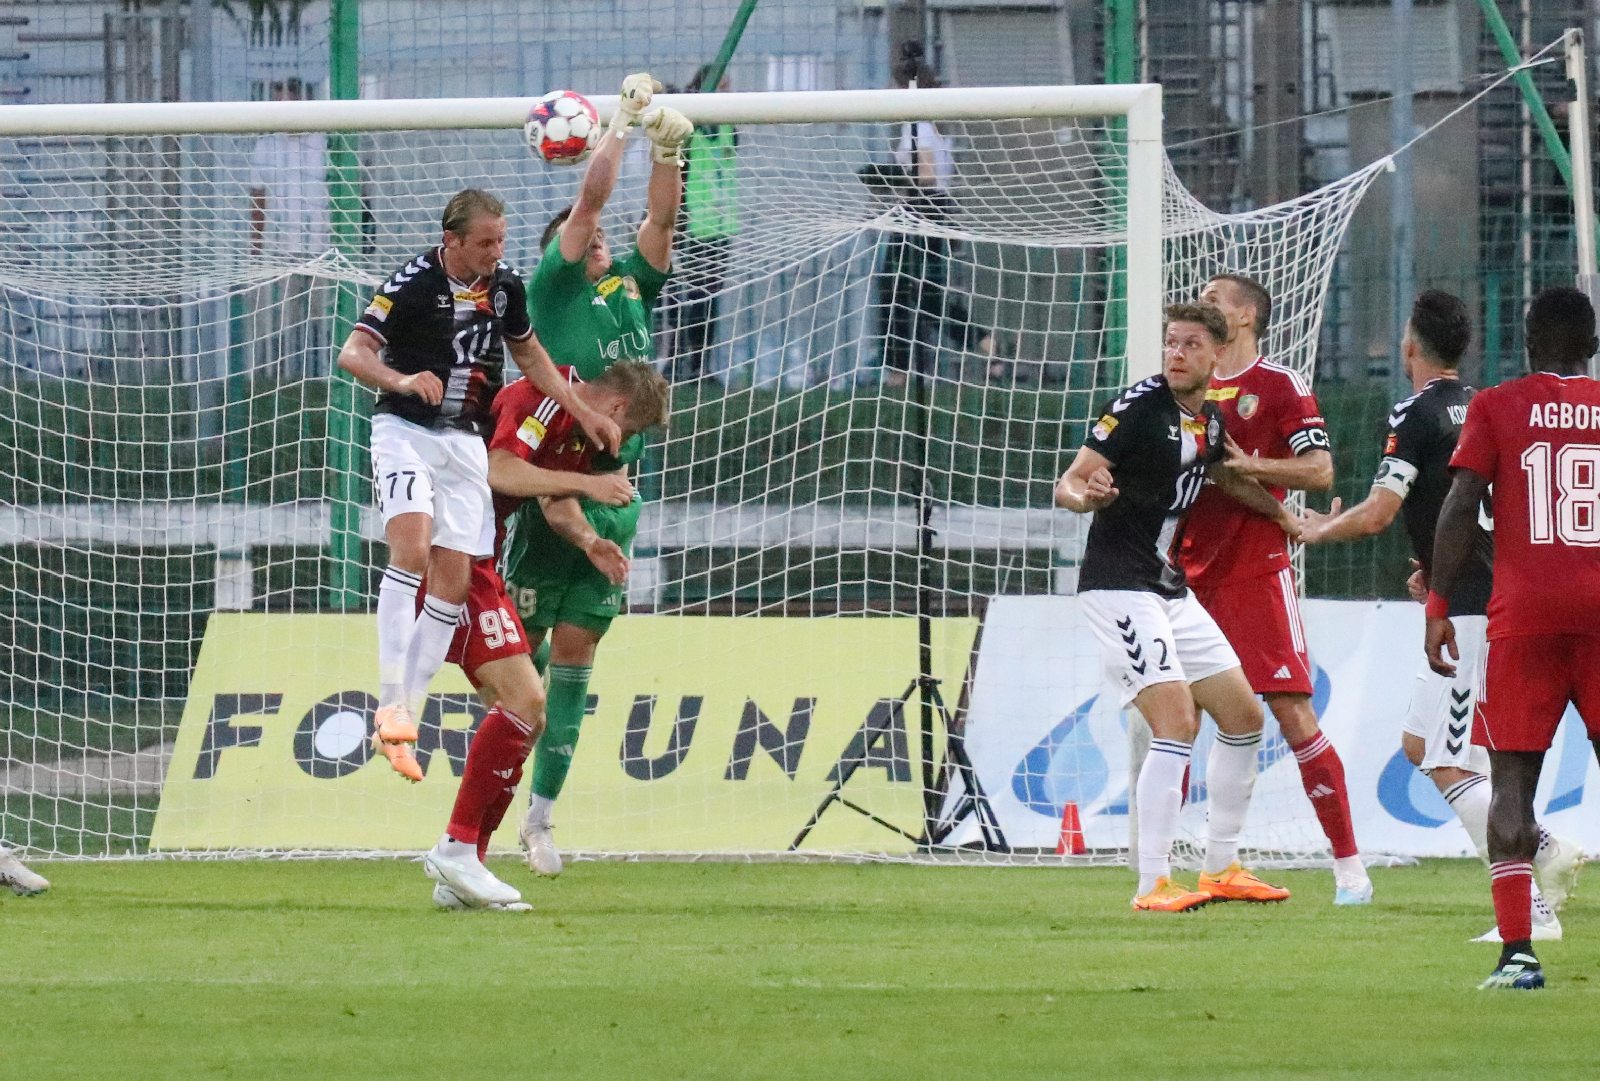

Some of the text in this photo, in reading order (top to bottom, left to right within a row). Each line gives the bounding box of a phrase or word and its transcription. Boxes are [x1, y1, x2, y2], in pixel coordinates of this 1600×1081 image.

[1529, 402, 1600, 430] AGBOR
[386, 470, 416, 500] 77
[1520, 441, 1600, 548] 18
[479, 607, 521, 650] 95
[1153, 637, 1171, 671] 2
[192, 690, 912, 781] FORUNA
